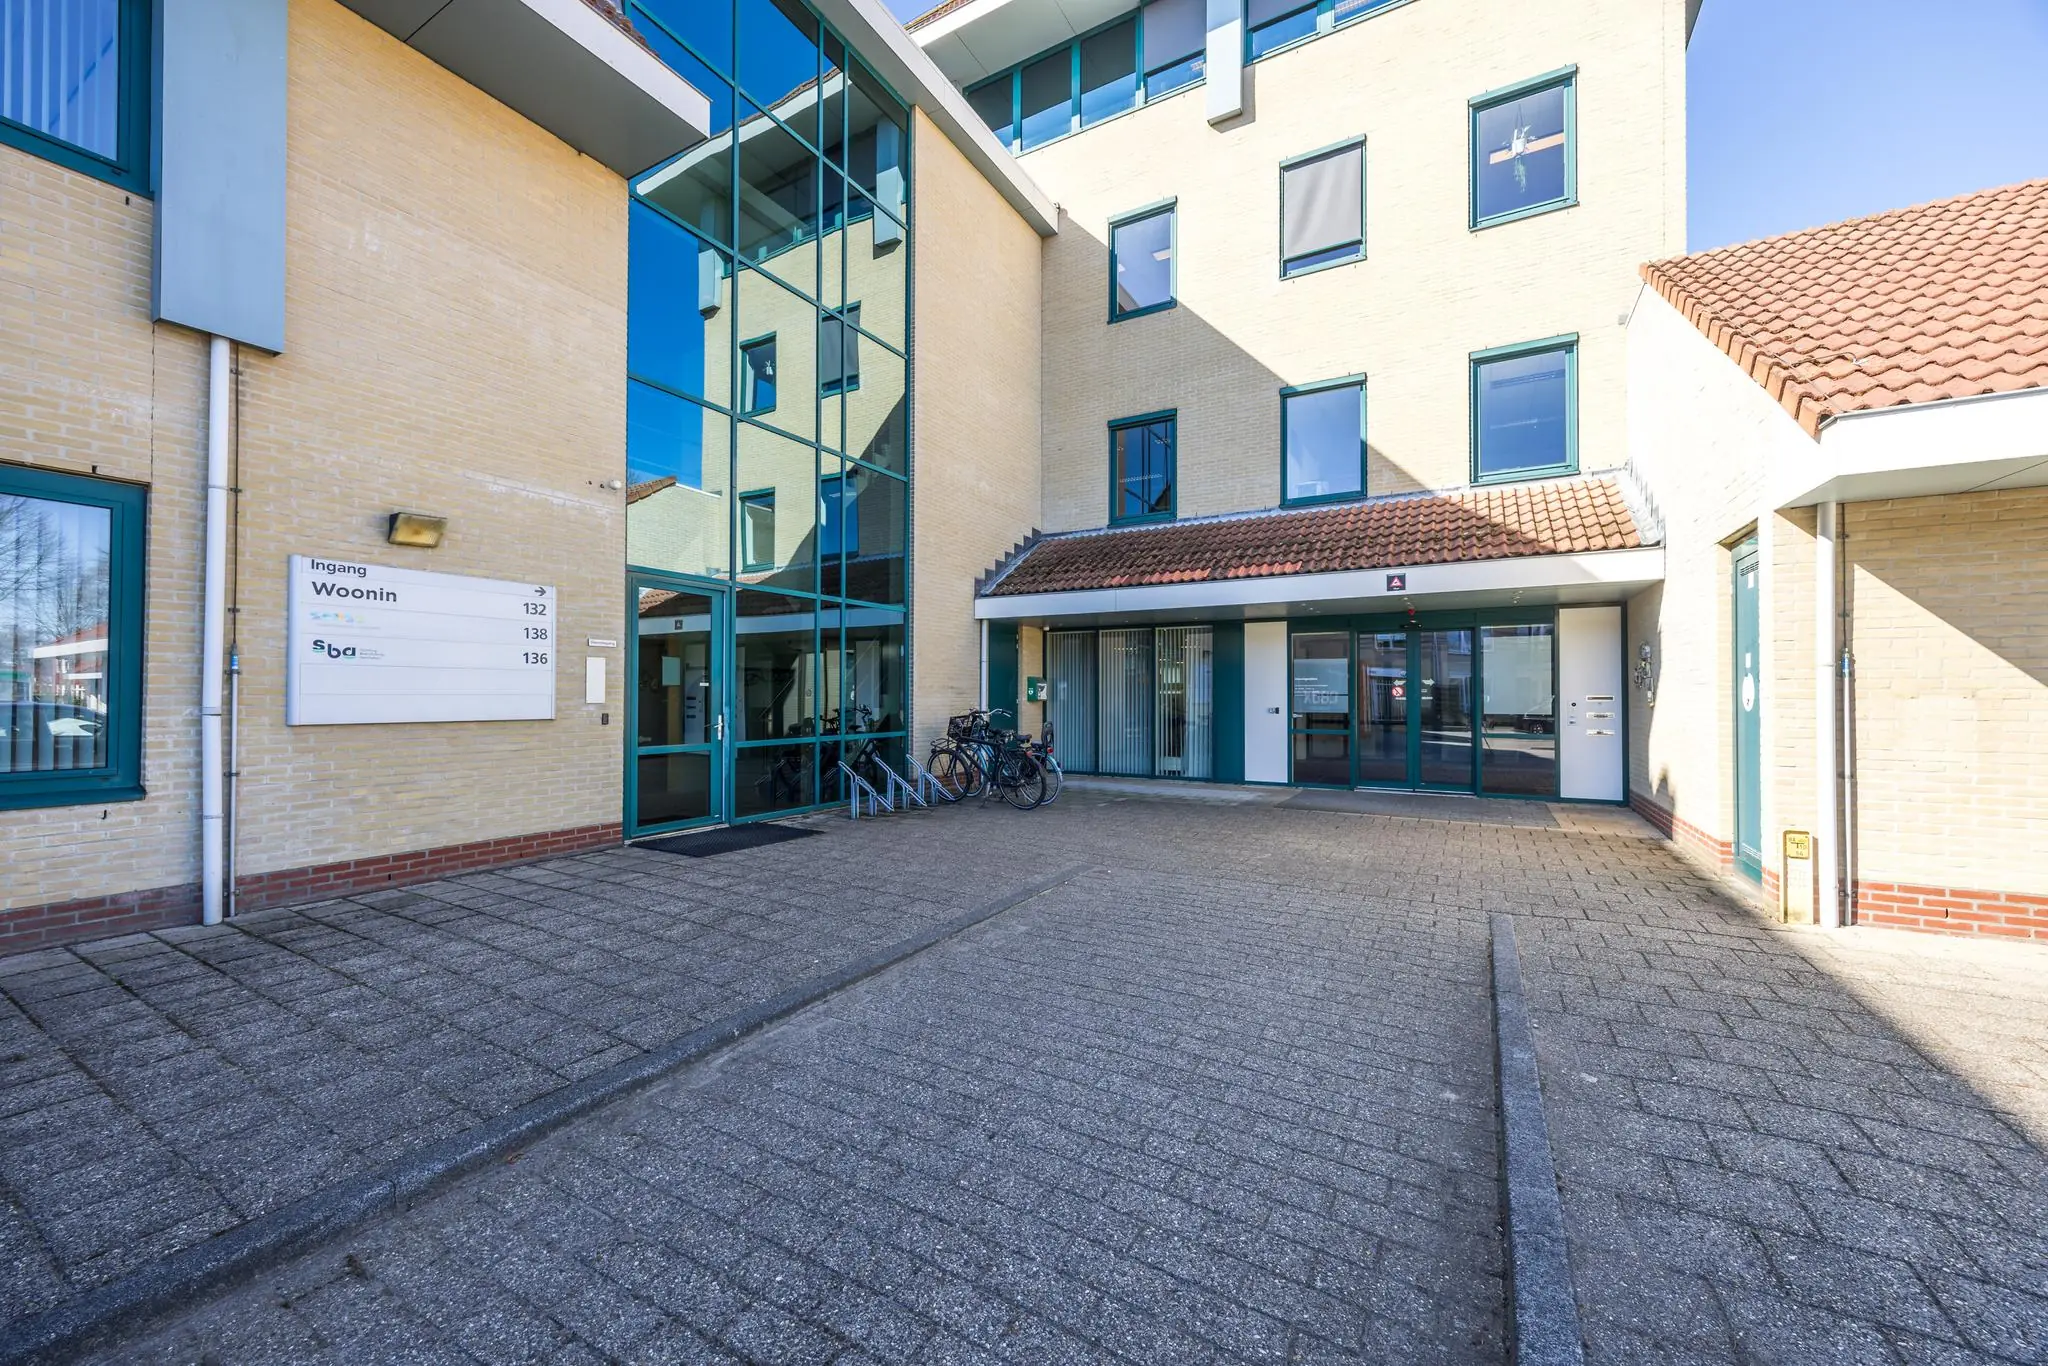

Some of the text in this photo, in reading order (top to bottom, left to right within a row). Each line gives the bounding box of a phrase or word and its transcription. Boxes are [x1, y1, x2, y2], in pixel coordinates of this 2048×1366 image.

[311, 558, 367, 578] Ingang
[311, 581, 397, 602] Woonin
[523, 602, 547, 616] 132
[523, 627, 548, 640] 138
[312, 639, 357, 659] sba
[523, 652, 548, 665] 136
